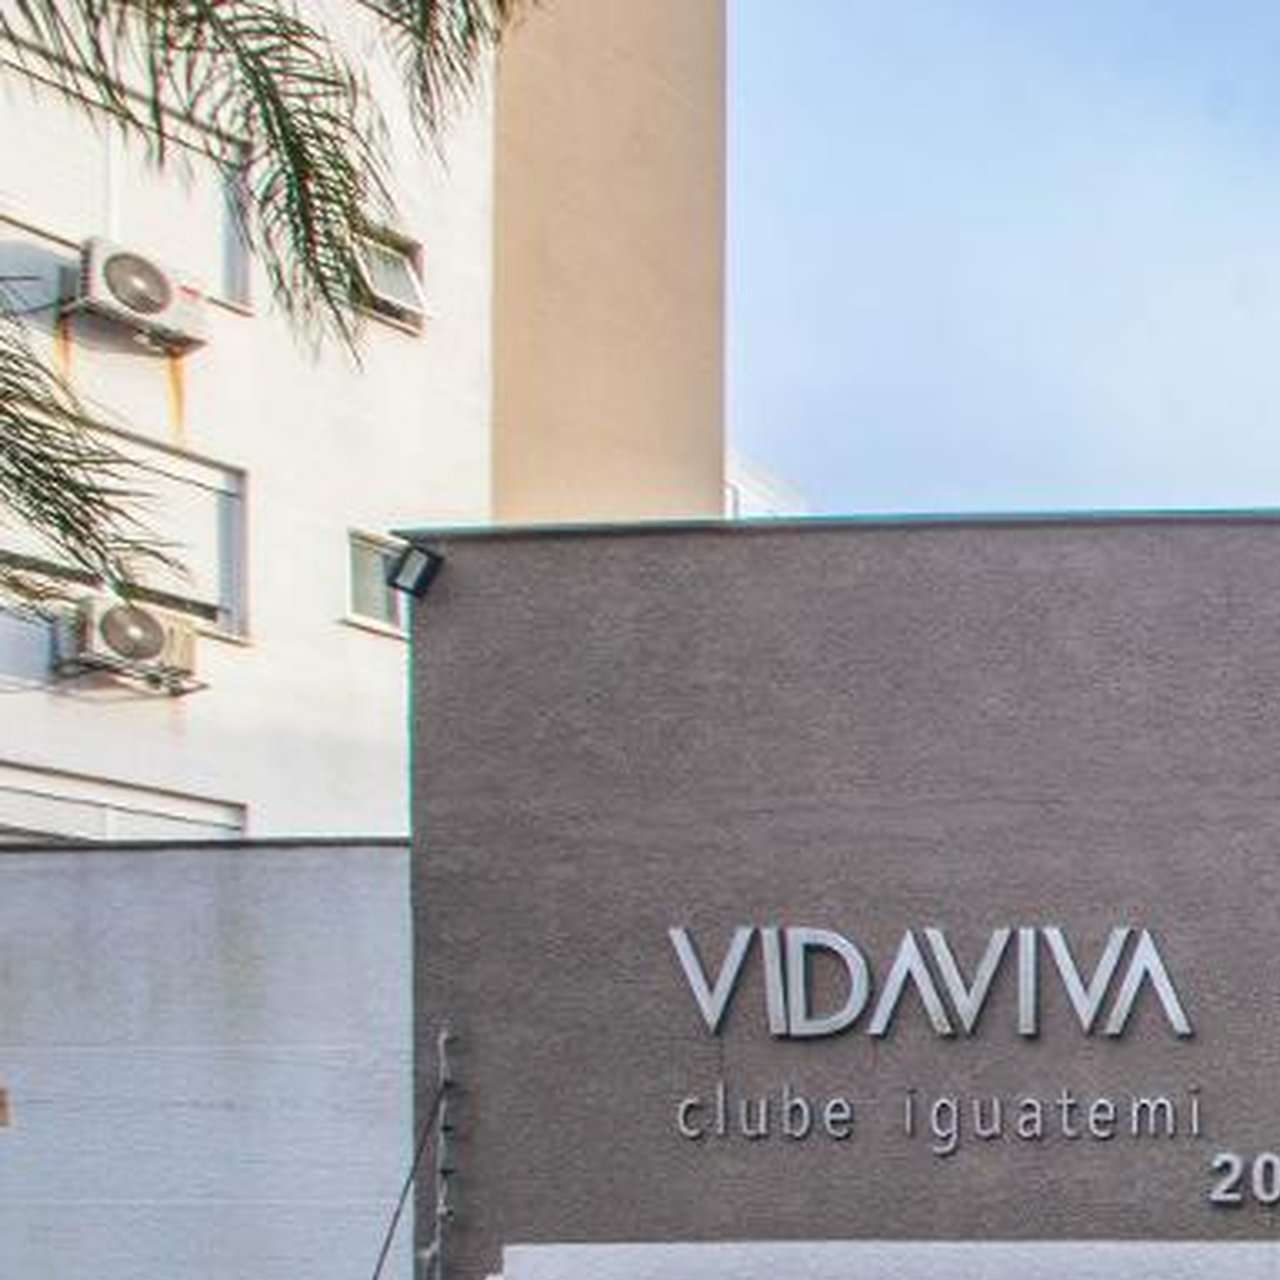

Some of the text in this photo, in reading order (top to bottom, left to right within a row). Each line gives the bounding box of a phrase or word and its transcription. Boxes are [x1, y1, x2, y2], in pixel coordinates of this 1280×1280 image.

[668, 926, 1194, 1037] VIDAVIVA
[677, 1083, 1201, 1155] clube iguatemi
